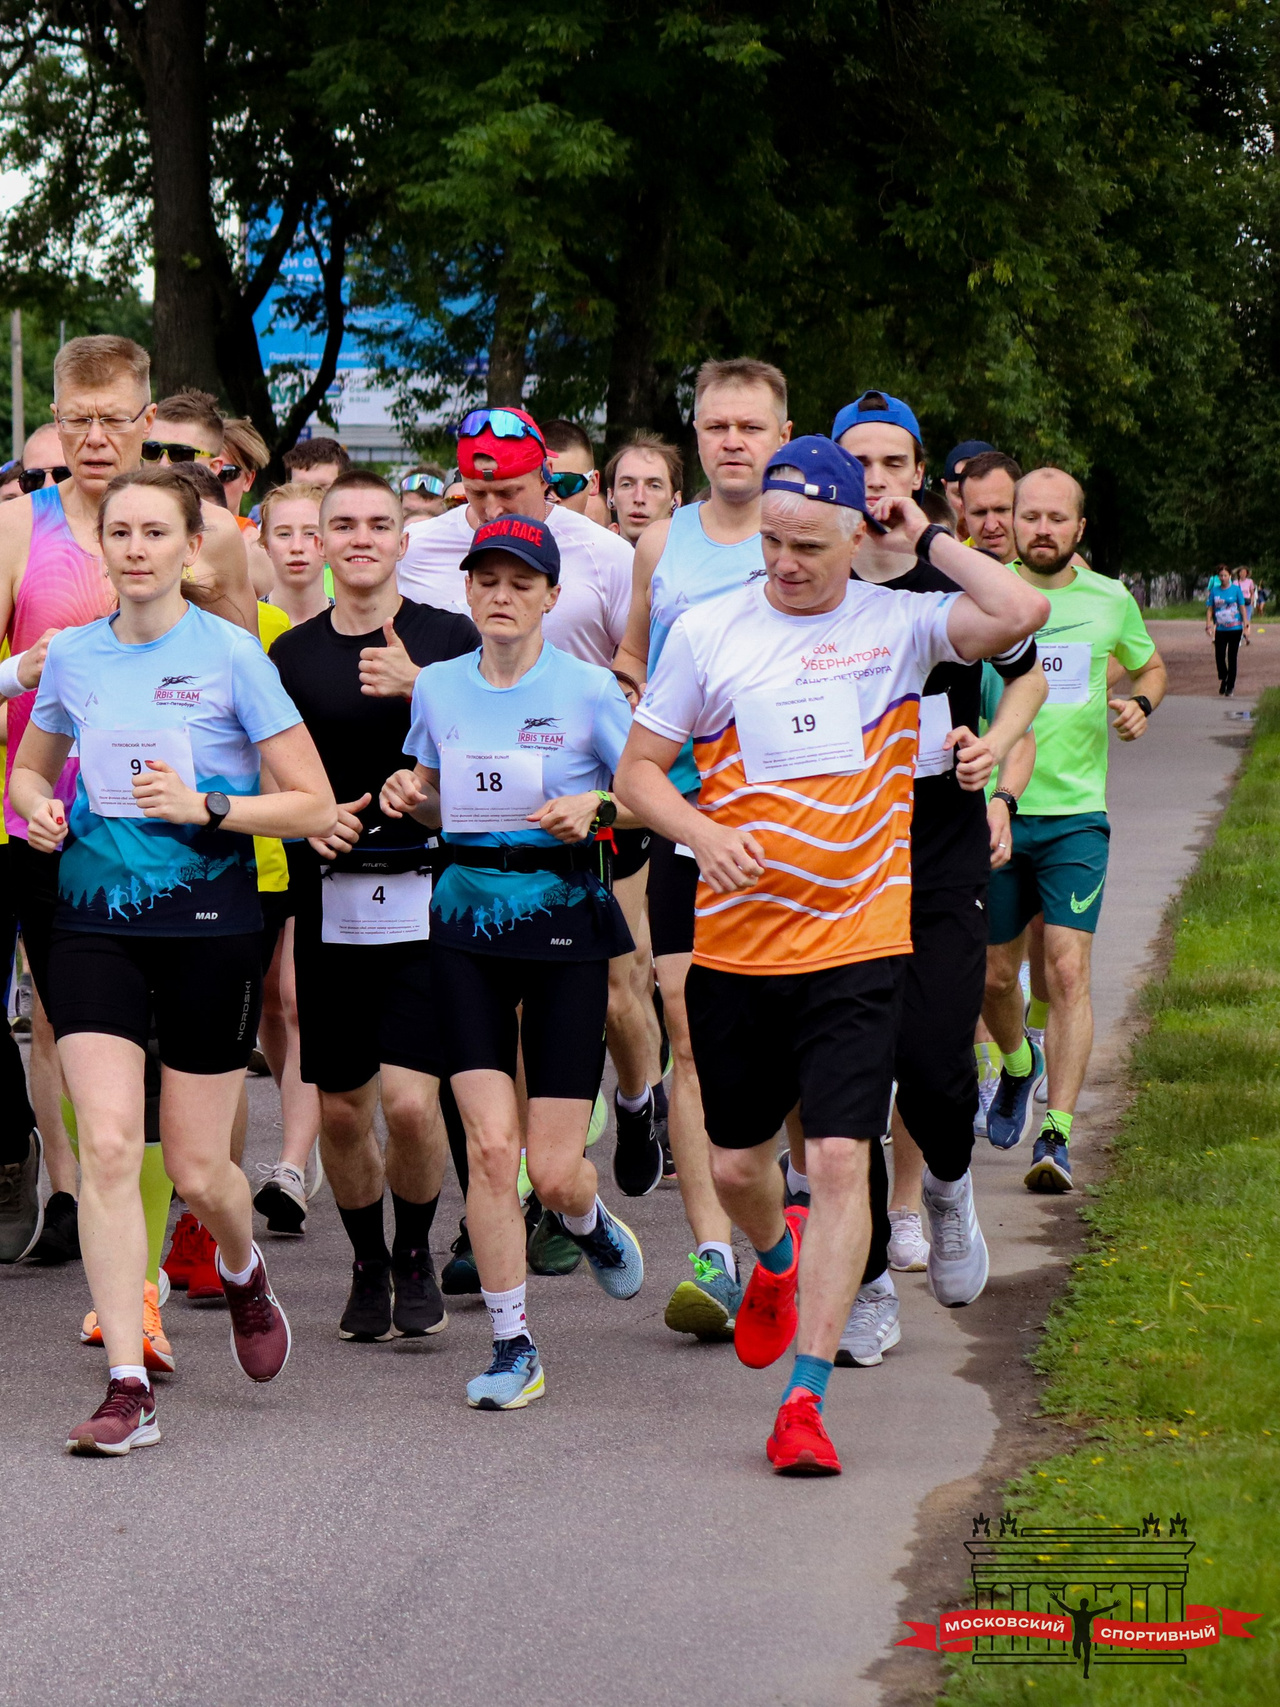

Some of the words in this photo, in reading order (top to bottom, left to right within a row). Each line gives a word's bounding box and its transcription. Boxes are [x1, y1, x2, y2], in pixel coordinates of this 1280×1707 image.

[510, 520, 544, 548] RACE
[1041, 657, 1063, 672] 60
[154, 690, 174, 700] IRBIS
[176, 691, 200, 702] TEAM
[791, 714, 816, 734] 19
[518, 732, 538, 742] IRBIS
[540, 734, 564, 745] TEAM
[130, 759, 142, 776] 9
[476, 772, 503, 792] 18
[372, 886, 386, 905] 4
[195, 912, 218, 920] MAD
[550, 937, 573, 946] MAD
[237, 981, 252, 1041] NORDSKI
